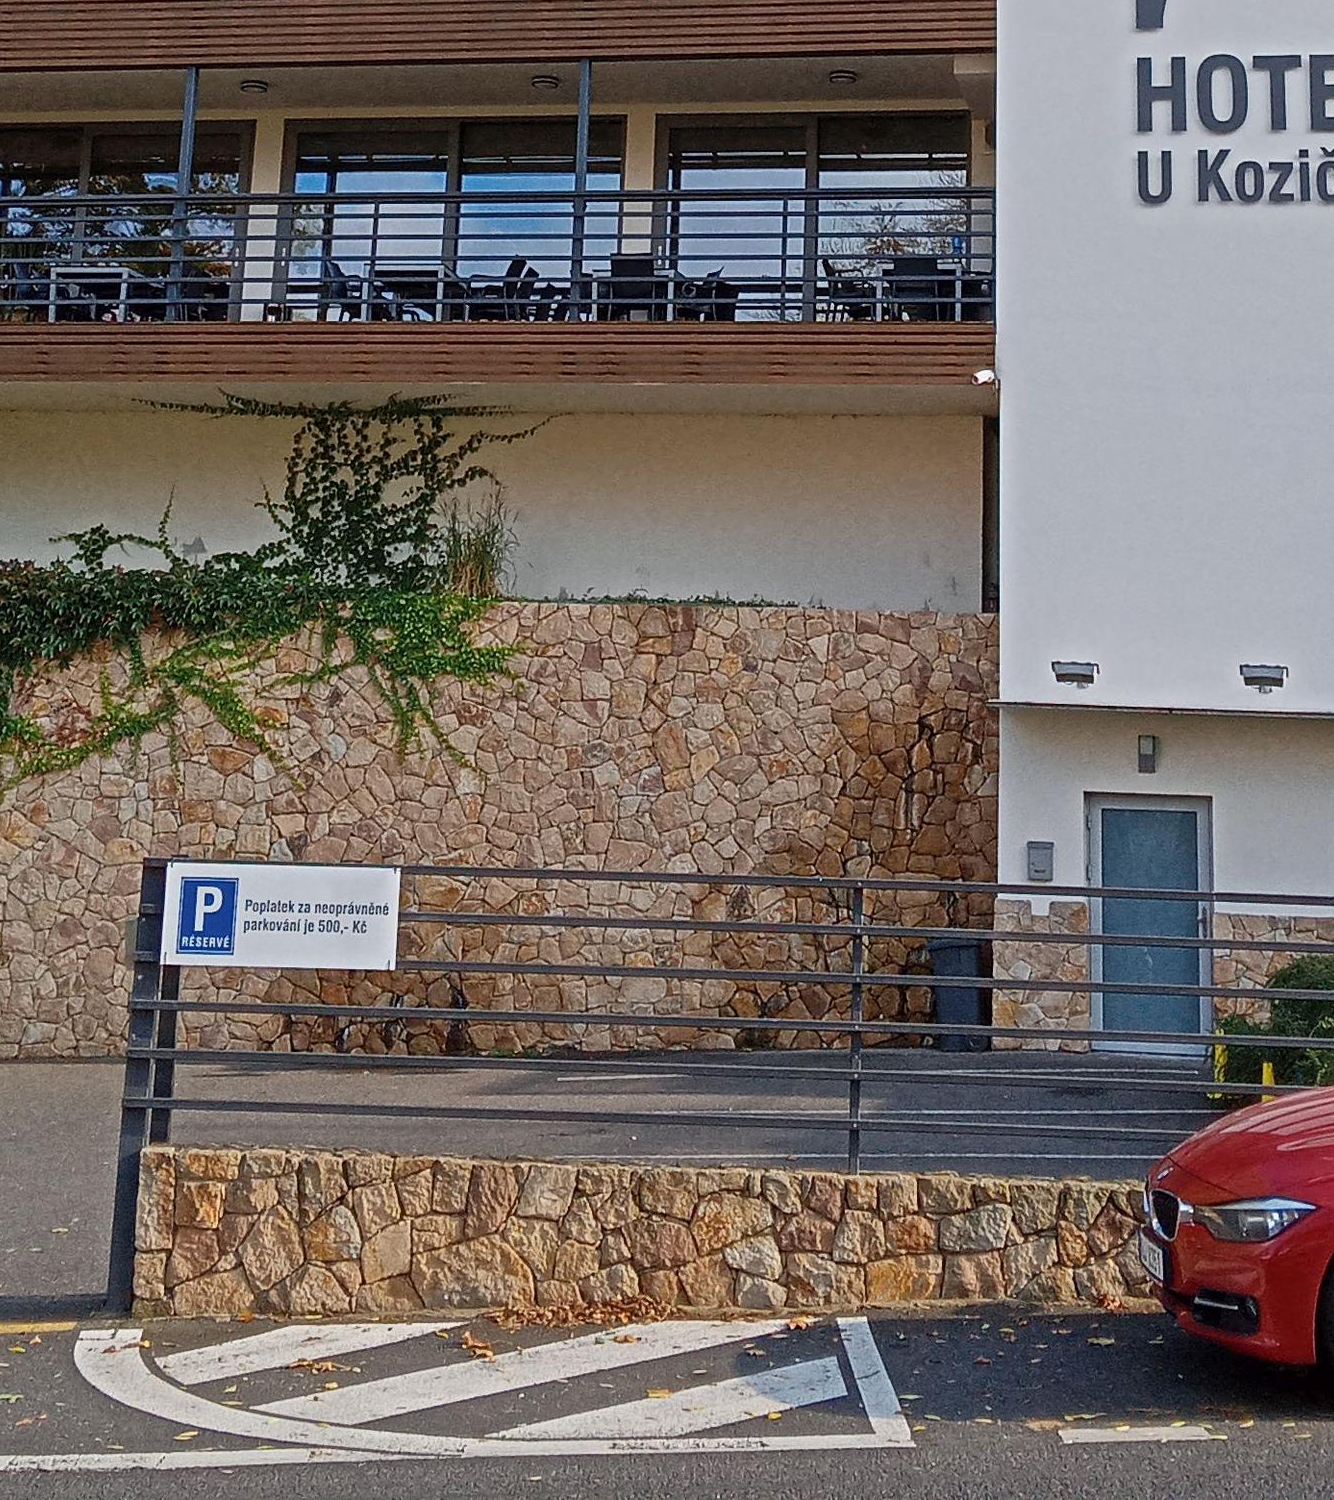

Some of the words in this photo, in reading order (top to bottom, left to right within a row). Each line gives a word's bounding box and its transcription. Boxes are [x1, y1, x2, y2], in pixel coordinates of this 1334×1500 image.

[1137, 150, 1173, 204] U
[194, 886, 223, 932] P
[244, 899, 295, 915] Poplatek
[297, 902, 311, 914] za
[314, 902, 389, 917] neoprávněné
[243, 918, 301, 934] parkování
[303, 919, 315, 935] je
[318, 919, 349, 935] 500,-
[352, 920, 368, 934] Kč
[181, 934, 230, 948] RÉSERVÉ
